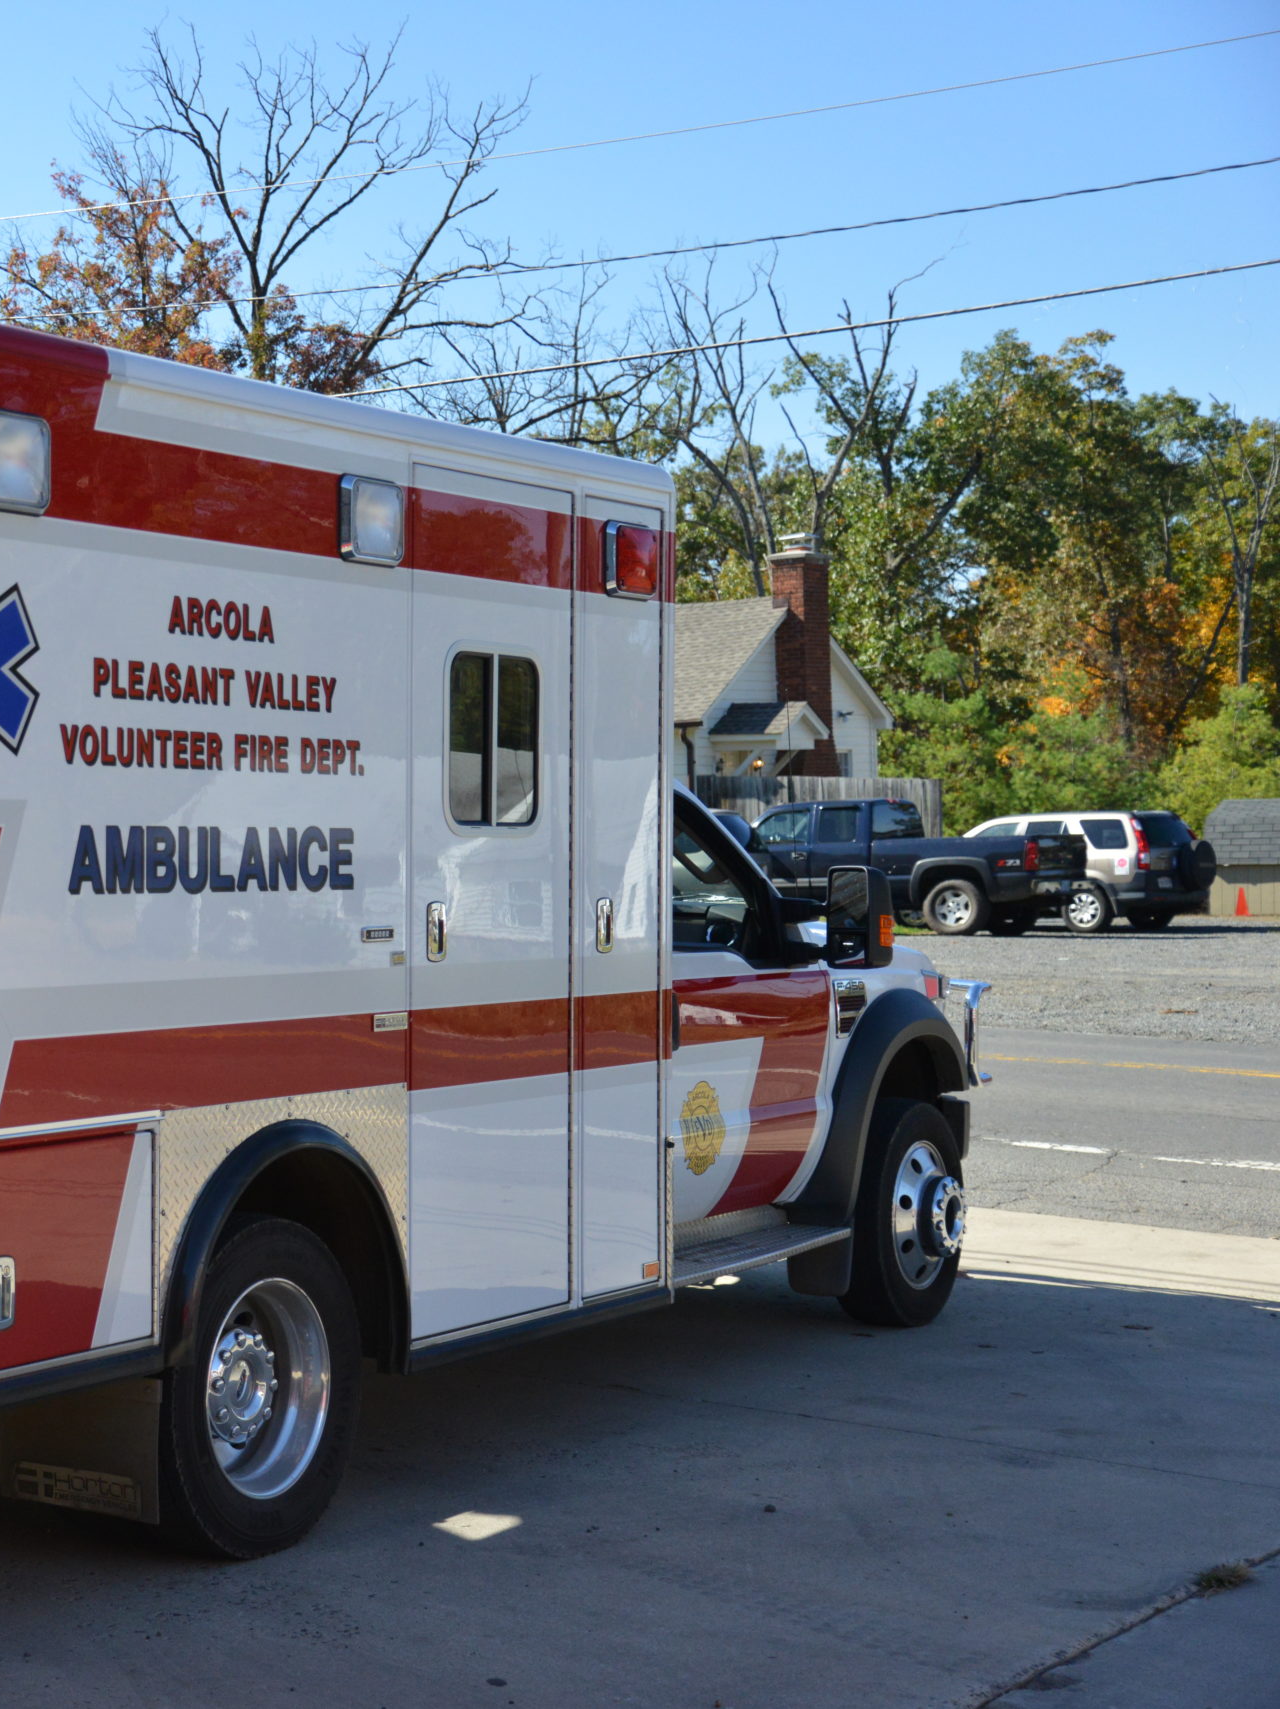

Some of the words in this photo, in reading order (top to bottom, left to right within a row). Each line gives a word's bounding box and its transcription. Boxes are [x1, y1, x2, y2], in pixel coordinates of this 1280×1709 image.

[168, 596, 275, 643] ARCOLA
[93, 657, 234, 706] PLEASANT
[245, 670, 336, 713] VALLEY
[60, 724, 223, 770] VOLUNTEER
[234, 734, 289, 774] FIRE
[300, 737, 365, 776] DEPT.
[68, 825, 354, 894] AMBULANCE
[55, 1471, 137, 1502] Horton
